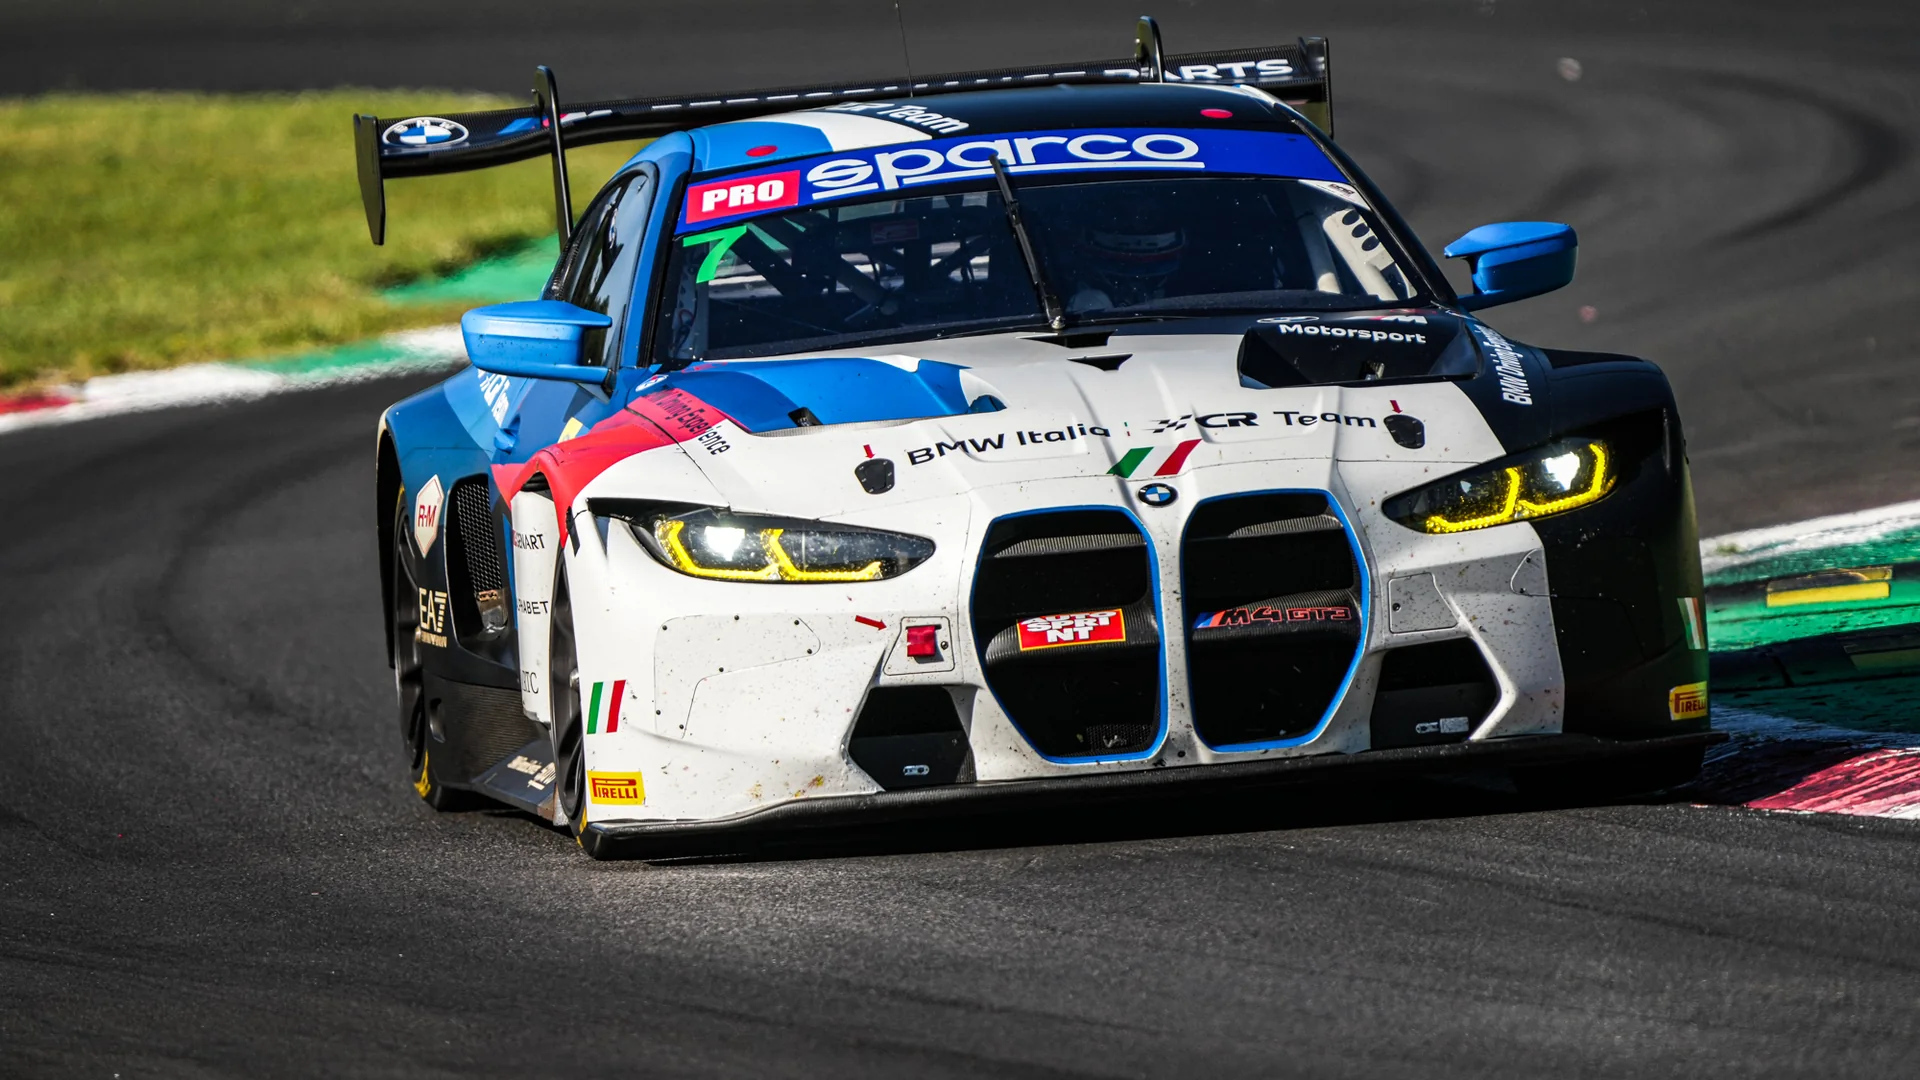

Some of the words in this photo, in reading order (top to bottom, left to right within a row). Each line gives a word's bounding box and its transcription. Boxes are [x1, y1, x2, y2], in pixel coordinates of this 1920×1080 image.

[876, 105, 969, 134] Team
[807, 133, 1199, 190] sparco
[702, 180, 785, 213] PRO
[683, 225, 747, 284] 7
[1279, 324, 1427, 343] Motorsport
[1497, 372, 1533, 405] BMW
[677, 407, 731, 456] Experience
[907, 433, 1005, 466] BMW
[1016, 423, 1111, 446] Italia
[1194, 411, 1260, 429] CR
[1272, 410, 1377, 429] Team
[418, 587, 448, 634] EA7
[1021, 611, 1117, 625] AUTO
[1286, 606, 1352, 622] GT3
[1046, 626, 1094, 643] NT
[591, 777, 639, 799] PIRELLI
